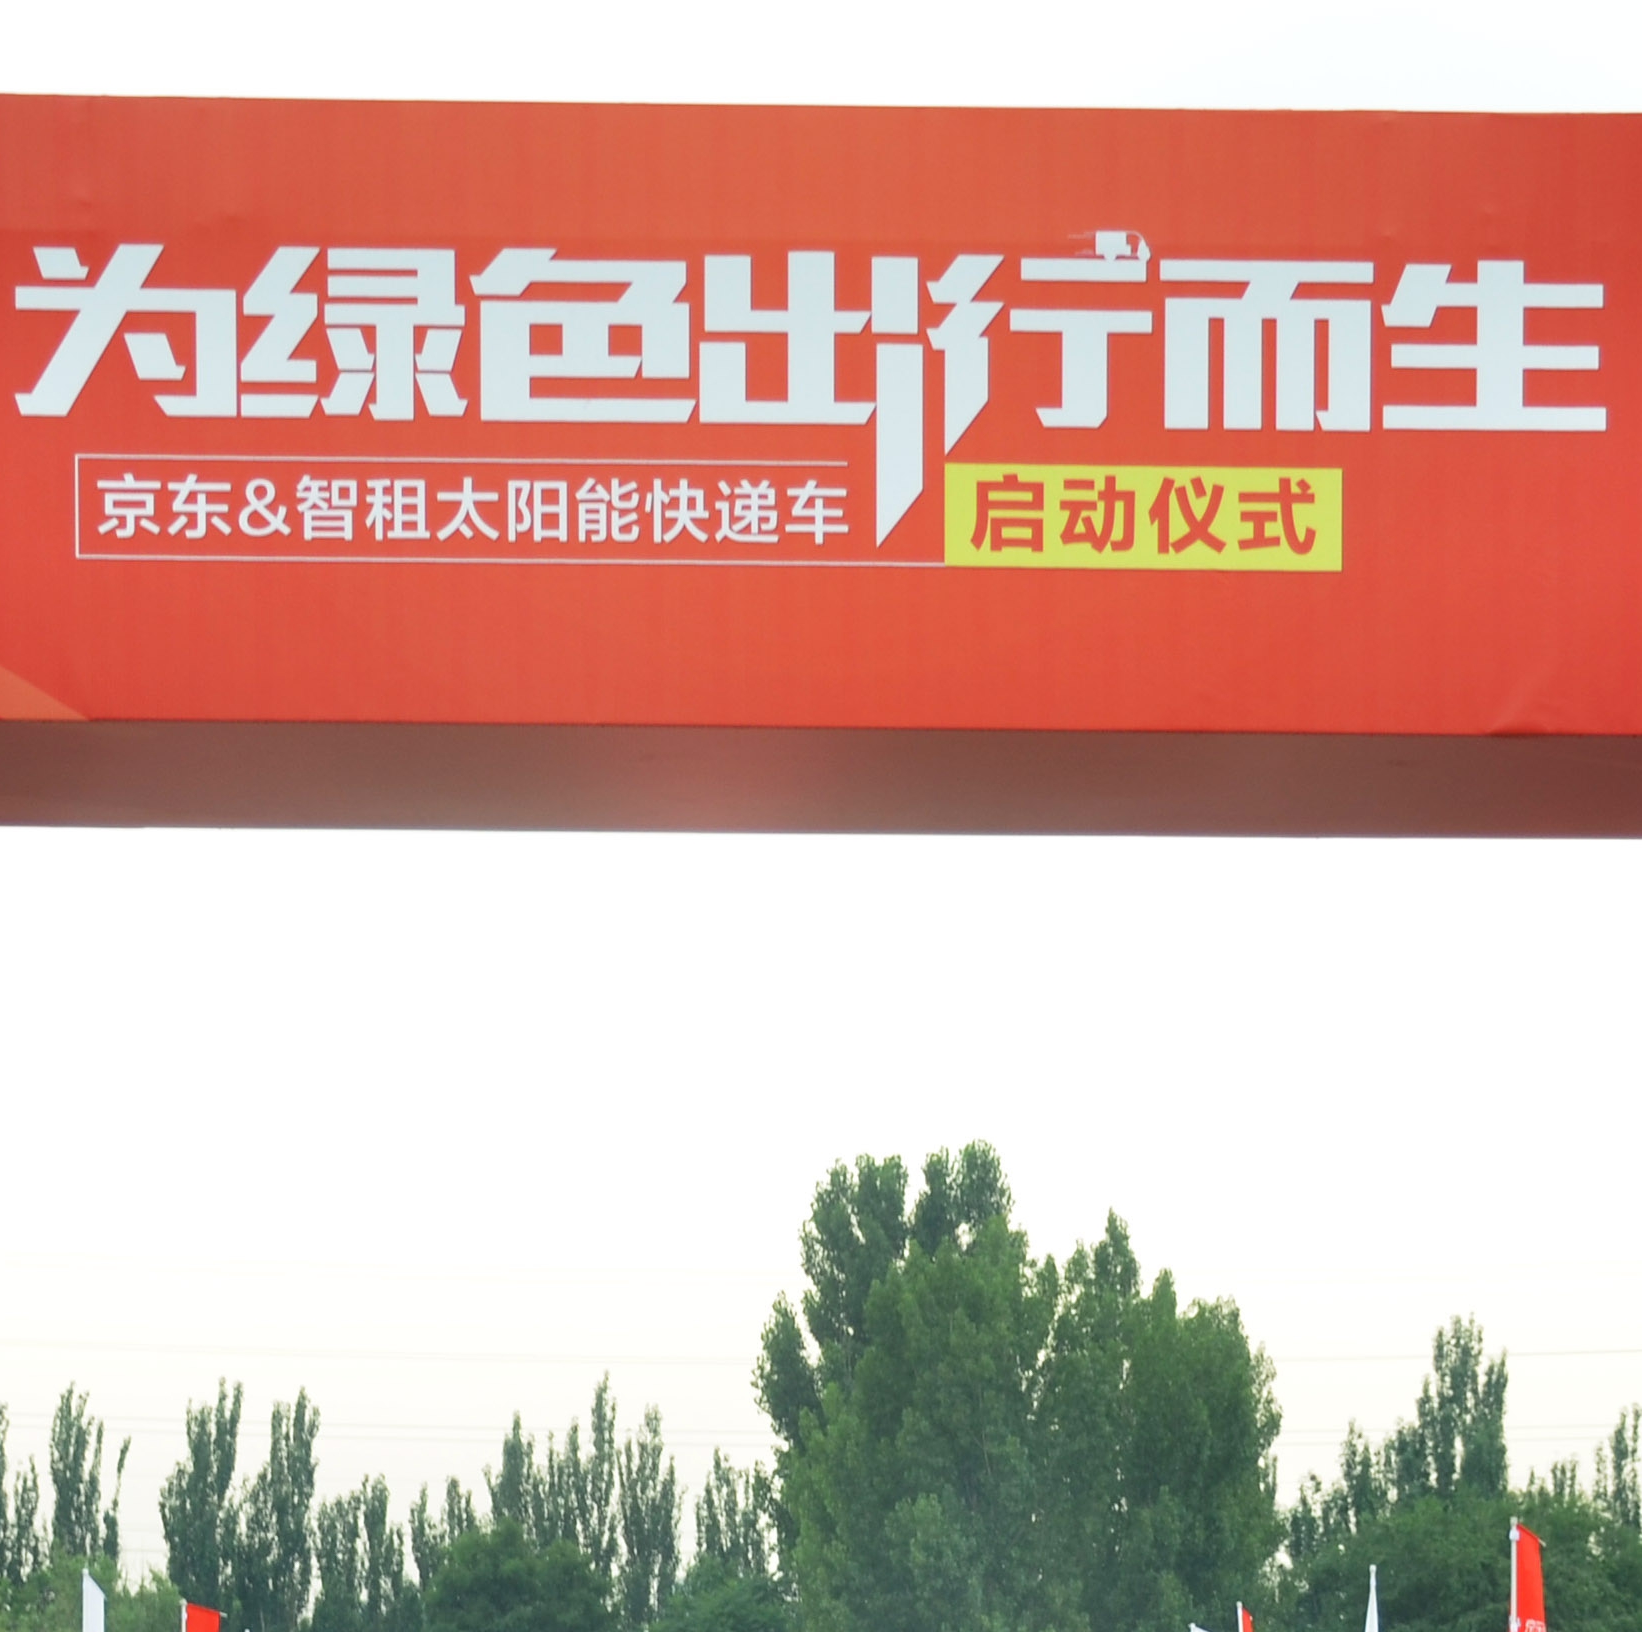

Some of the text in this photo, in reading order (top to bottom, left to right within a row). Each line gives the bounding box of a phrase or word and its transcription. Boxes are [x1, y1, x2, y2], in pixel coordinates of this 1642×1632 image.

[14, 240, 1607, 548] 为绿色出行而生
[95, 473, 849, 545] 京东&智租太阳能快递车
[969, 473, 1317, 556] 启动仪式
